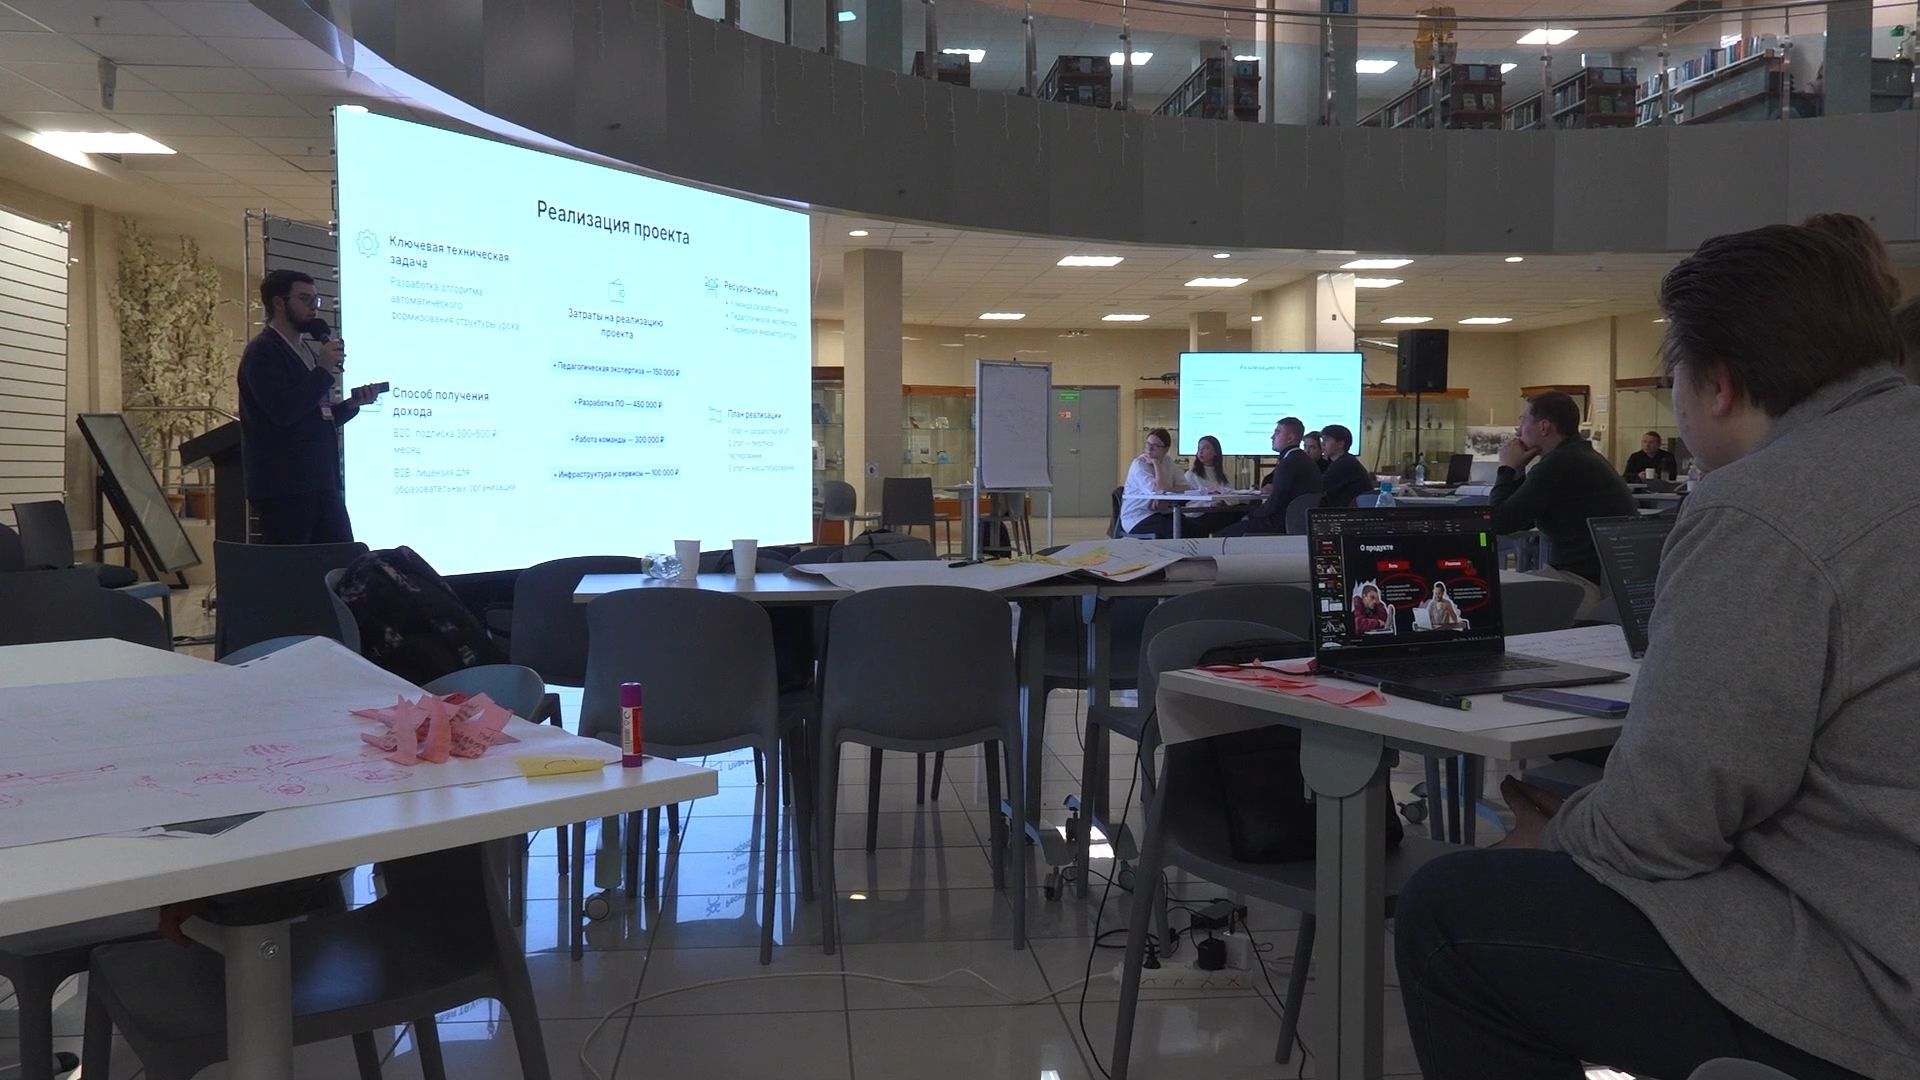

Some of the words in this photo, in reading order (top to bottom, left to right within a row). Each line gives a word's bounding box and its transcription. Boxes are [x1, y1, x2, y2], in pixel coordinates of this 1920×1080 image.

[537, 200, 630, 234] Реализация
[634, 223, 690, 245] проекта
[389, 235, 444, 254] Ключевая
[447, 244, 510, 263] техническая
[390, 255, 428, 269] задача
[568, 308, 603, 321] Затраты
[605, 314, 614, 322] на
[616, 314, 664, 328] реализацию
[601, 328, 634, 340] проекта
[392, 387, 433, 400] Способ
[435, 390, 490, 403] получения
[392, 407, 433, 418] дохода
